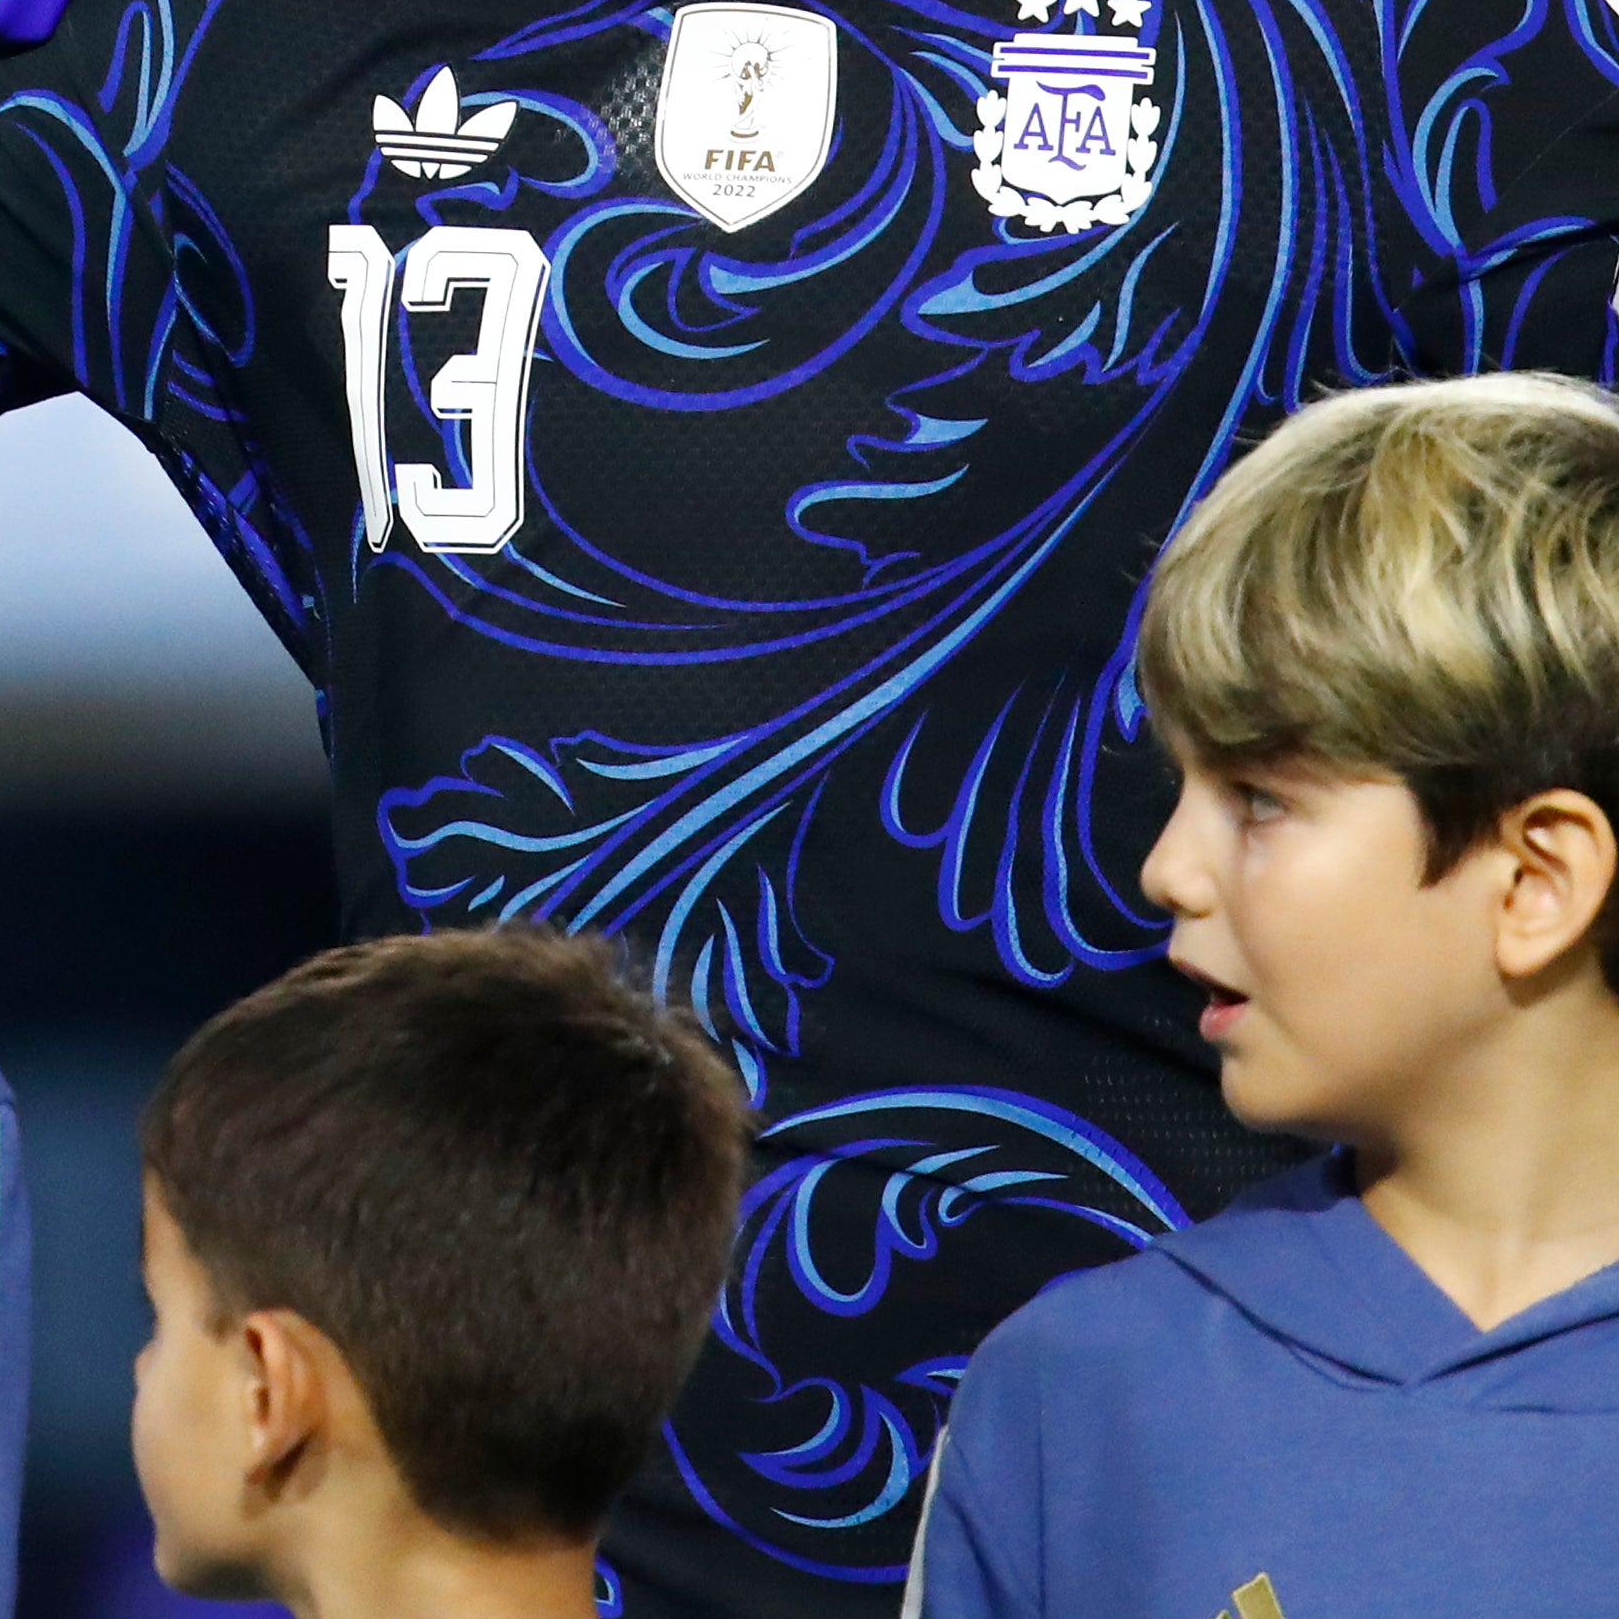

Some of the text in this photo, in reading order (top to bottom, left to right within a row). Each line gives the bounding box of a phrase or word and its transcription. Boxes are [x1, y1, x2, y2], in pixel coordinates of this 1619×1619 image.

[1013, 80, 1116, 171] AFA
[704, 149, 775, 172] FIFA
[683, 172, 792, 184] WORLD CHAMPIONS
[712, 183, 756, 198] 2022
[327, 224, 552, 555] 13
